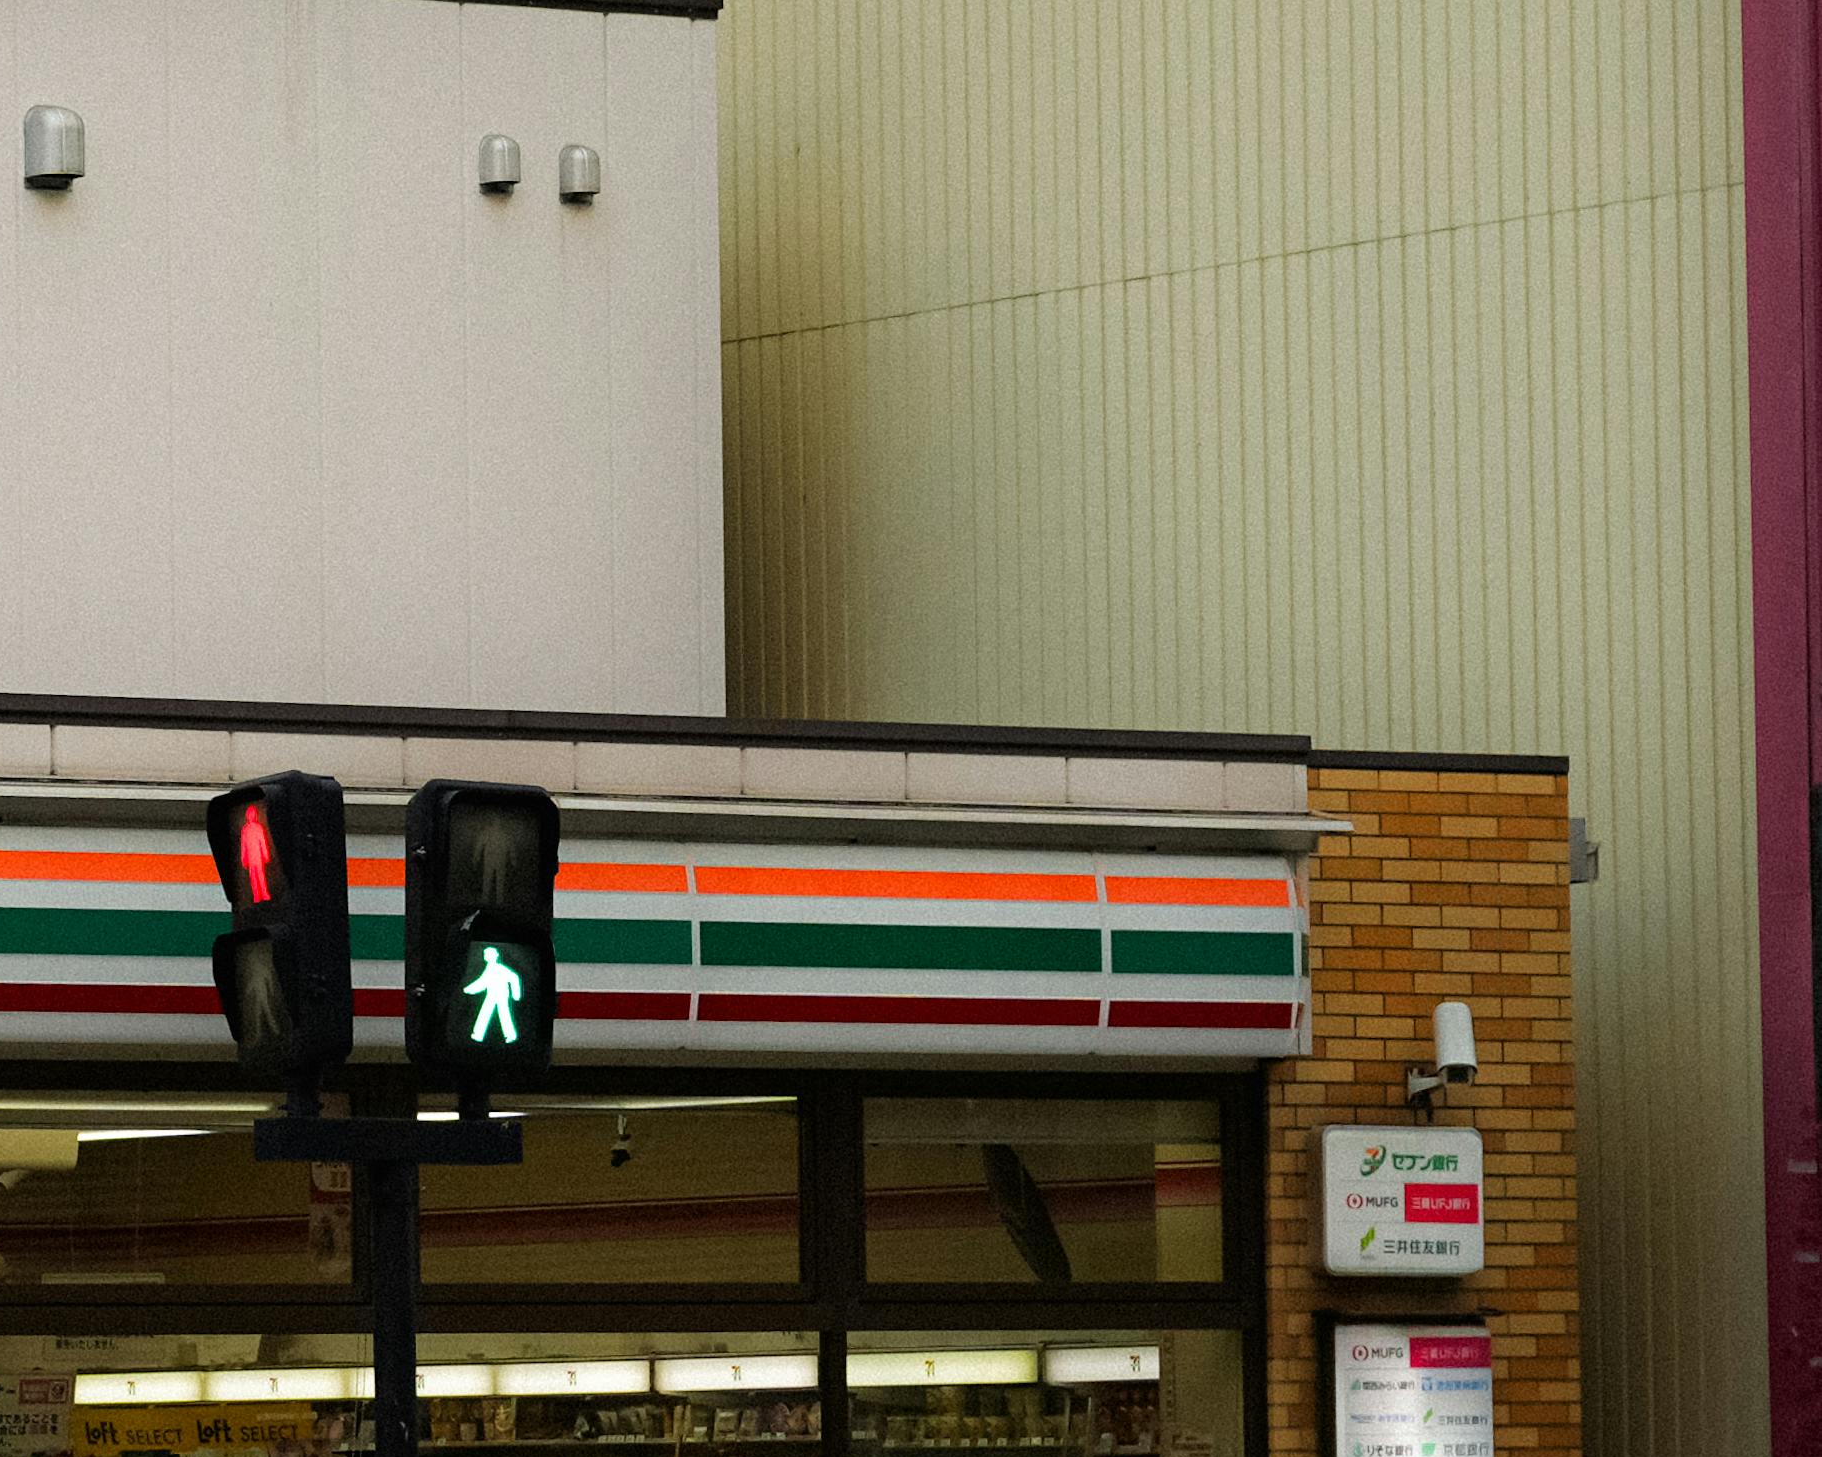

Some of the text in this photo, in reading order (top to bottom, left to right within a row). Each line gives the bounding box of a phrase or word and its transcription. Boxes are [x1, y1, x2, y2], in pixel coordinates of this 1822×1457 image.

[1392, 1154, 1459, 1171] セブン銀行
[1366, 1197, 1399, 1208] MUFG
[1383, 1240, 1460, 1256] 三井住友銀行
[1372, 1348, 1403, 1359] MUFG
[126, 1428, 183, 1444] SELECT
[240, 1424, 299, 1442] SELECT
[1367, 1444, 1413, 1456] りそな銀行
